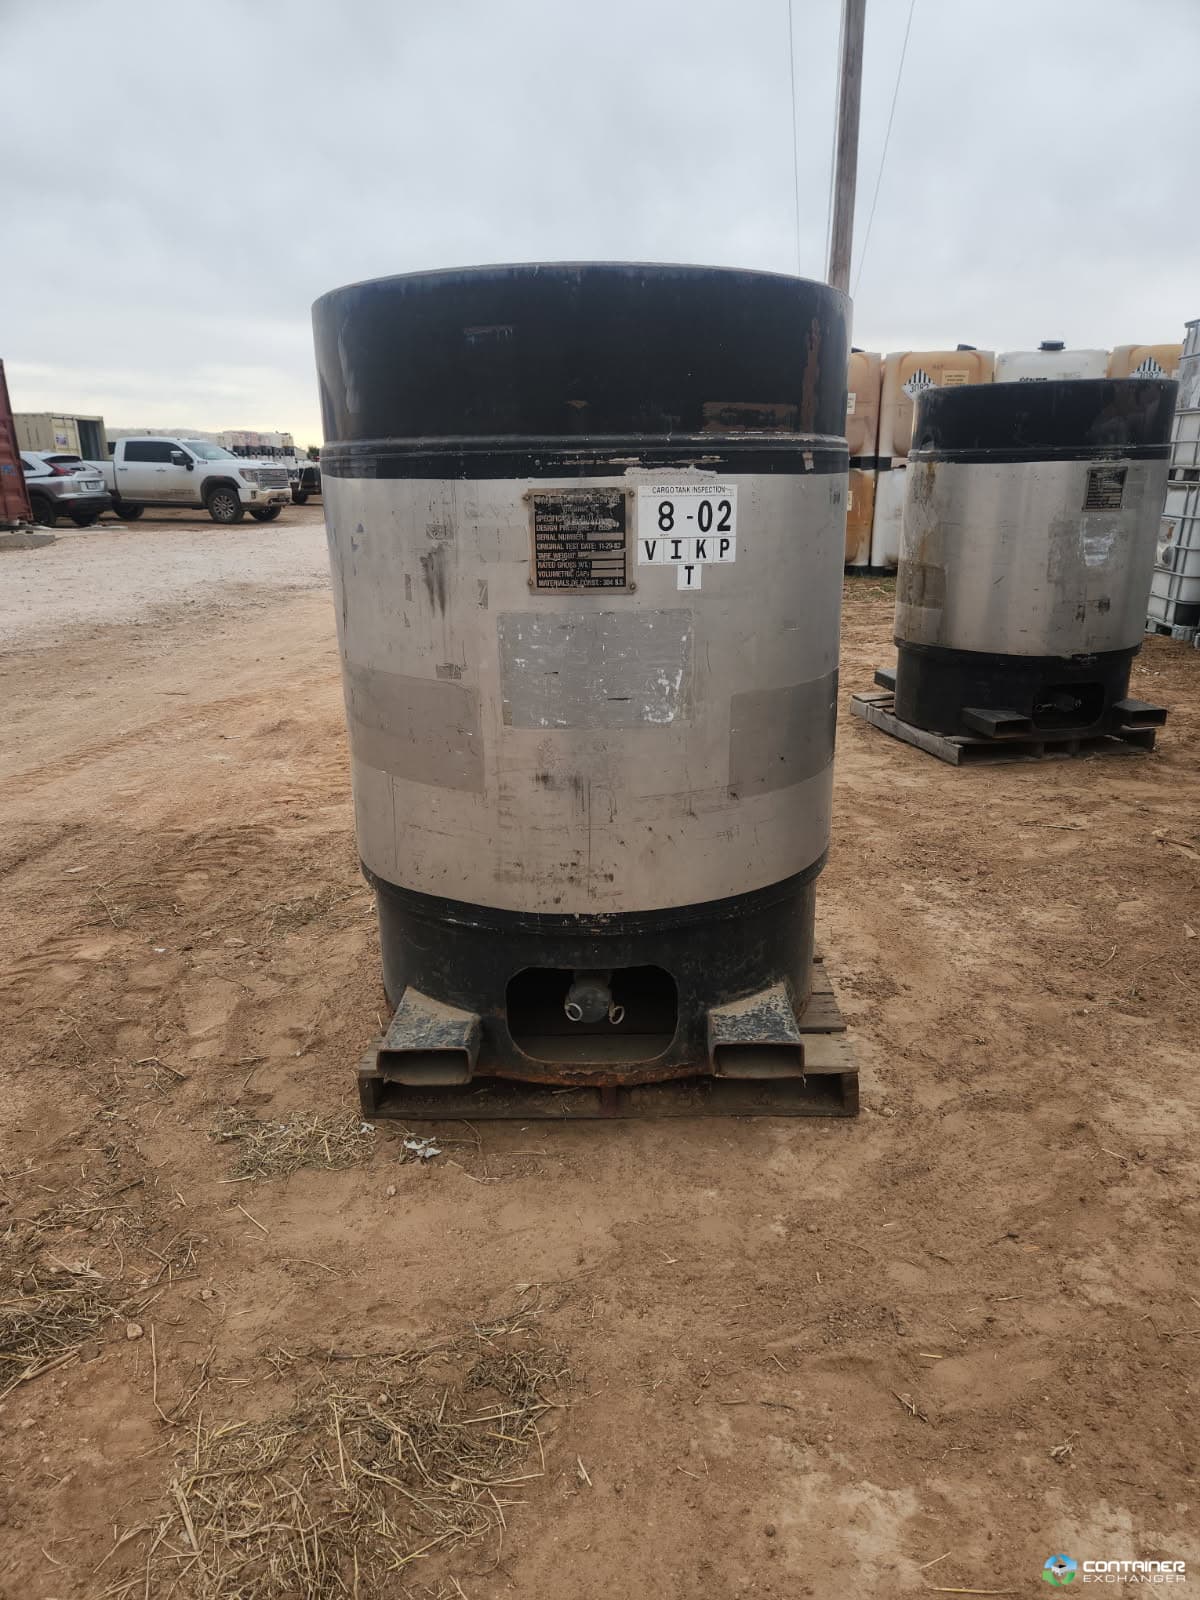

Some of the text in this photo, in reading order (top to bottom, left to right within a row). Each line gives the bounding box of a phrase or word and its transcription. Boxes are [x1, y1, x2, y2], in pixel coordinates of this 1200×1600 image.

[652, 486, 675, 494] CARGO
[692, 486, 726, 494] INSPECTION
[536, 532, 557, 541] SERIAL
[684, 565, 695, 585] T
